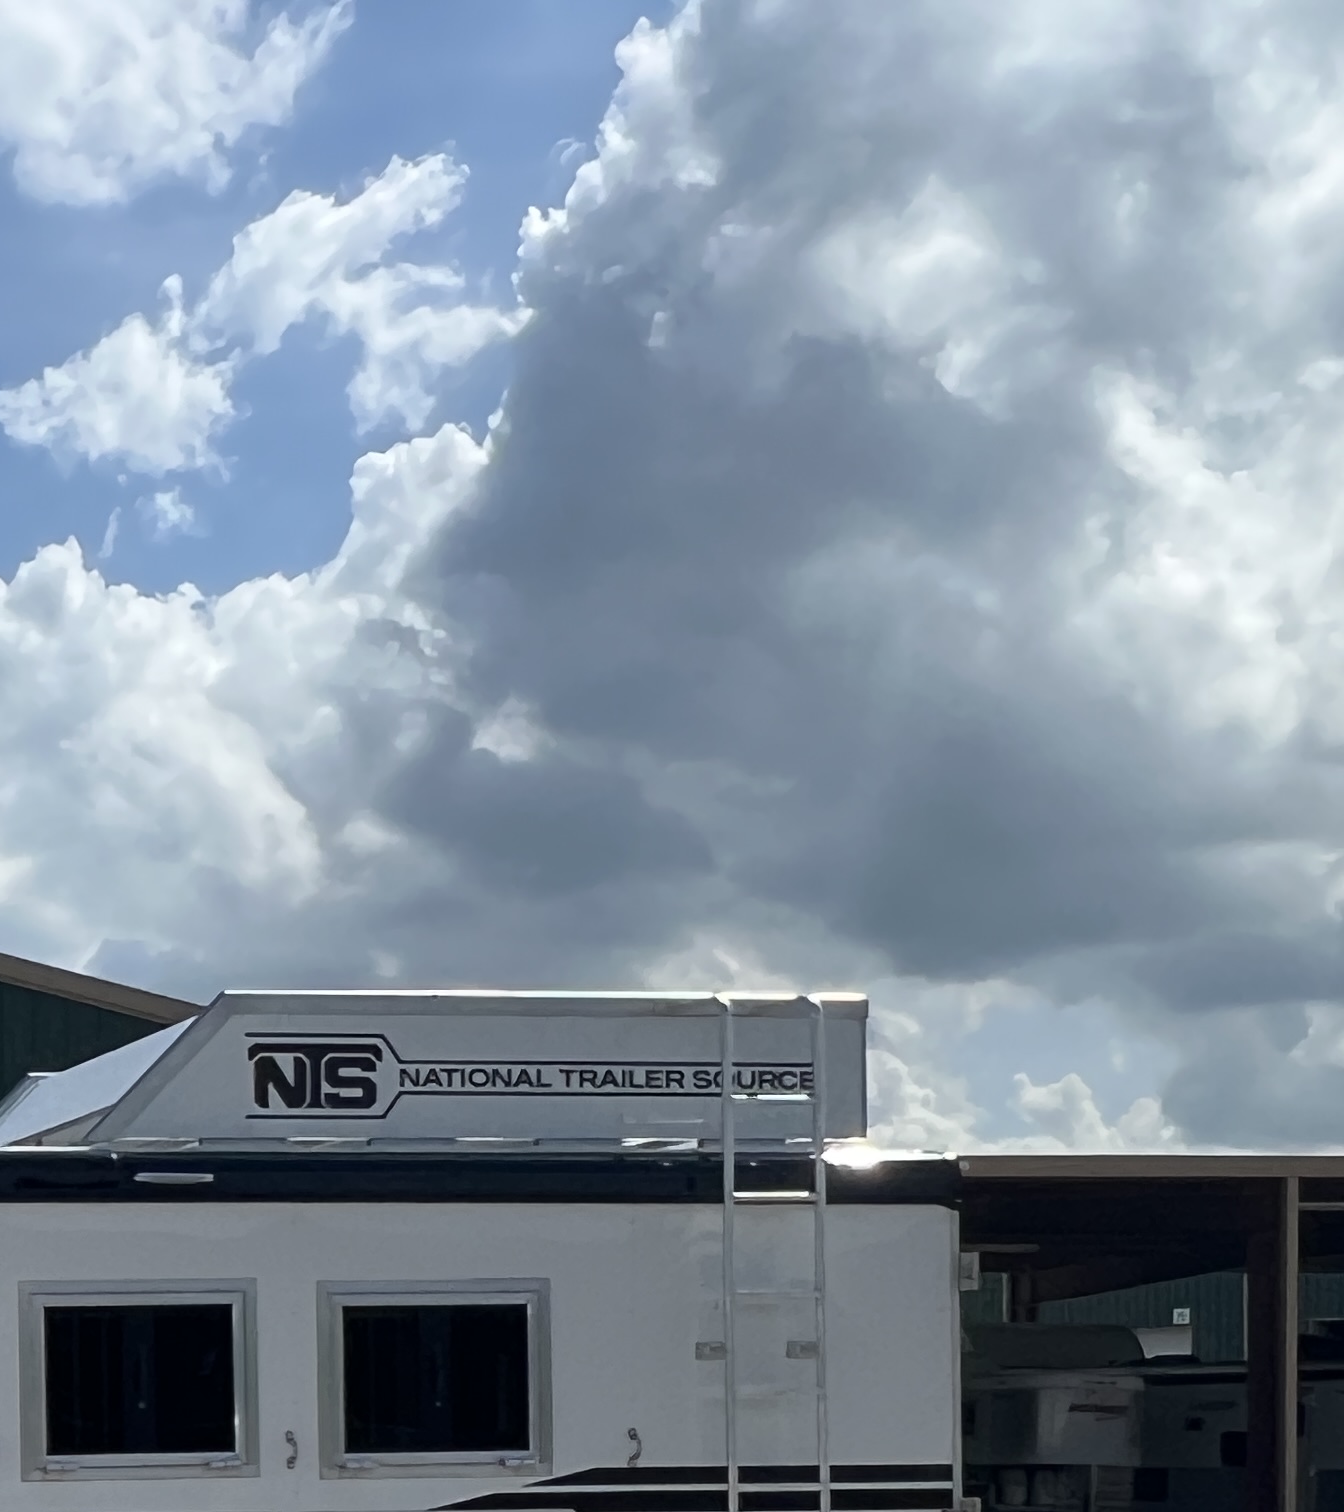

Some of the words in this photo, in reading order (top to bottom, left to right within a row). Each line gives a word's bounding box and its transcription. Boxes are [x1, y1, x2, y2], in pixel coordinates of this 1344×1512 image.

[247, 1043, 383, 1109] NTS
[399, 1068, 553, 1088] NATIONAL
[558, 1068, 686, 1089] TRAILER
